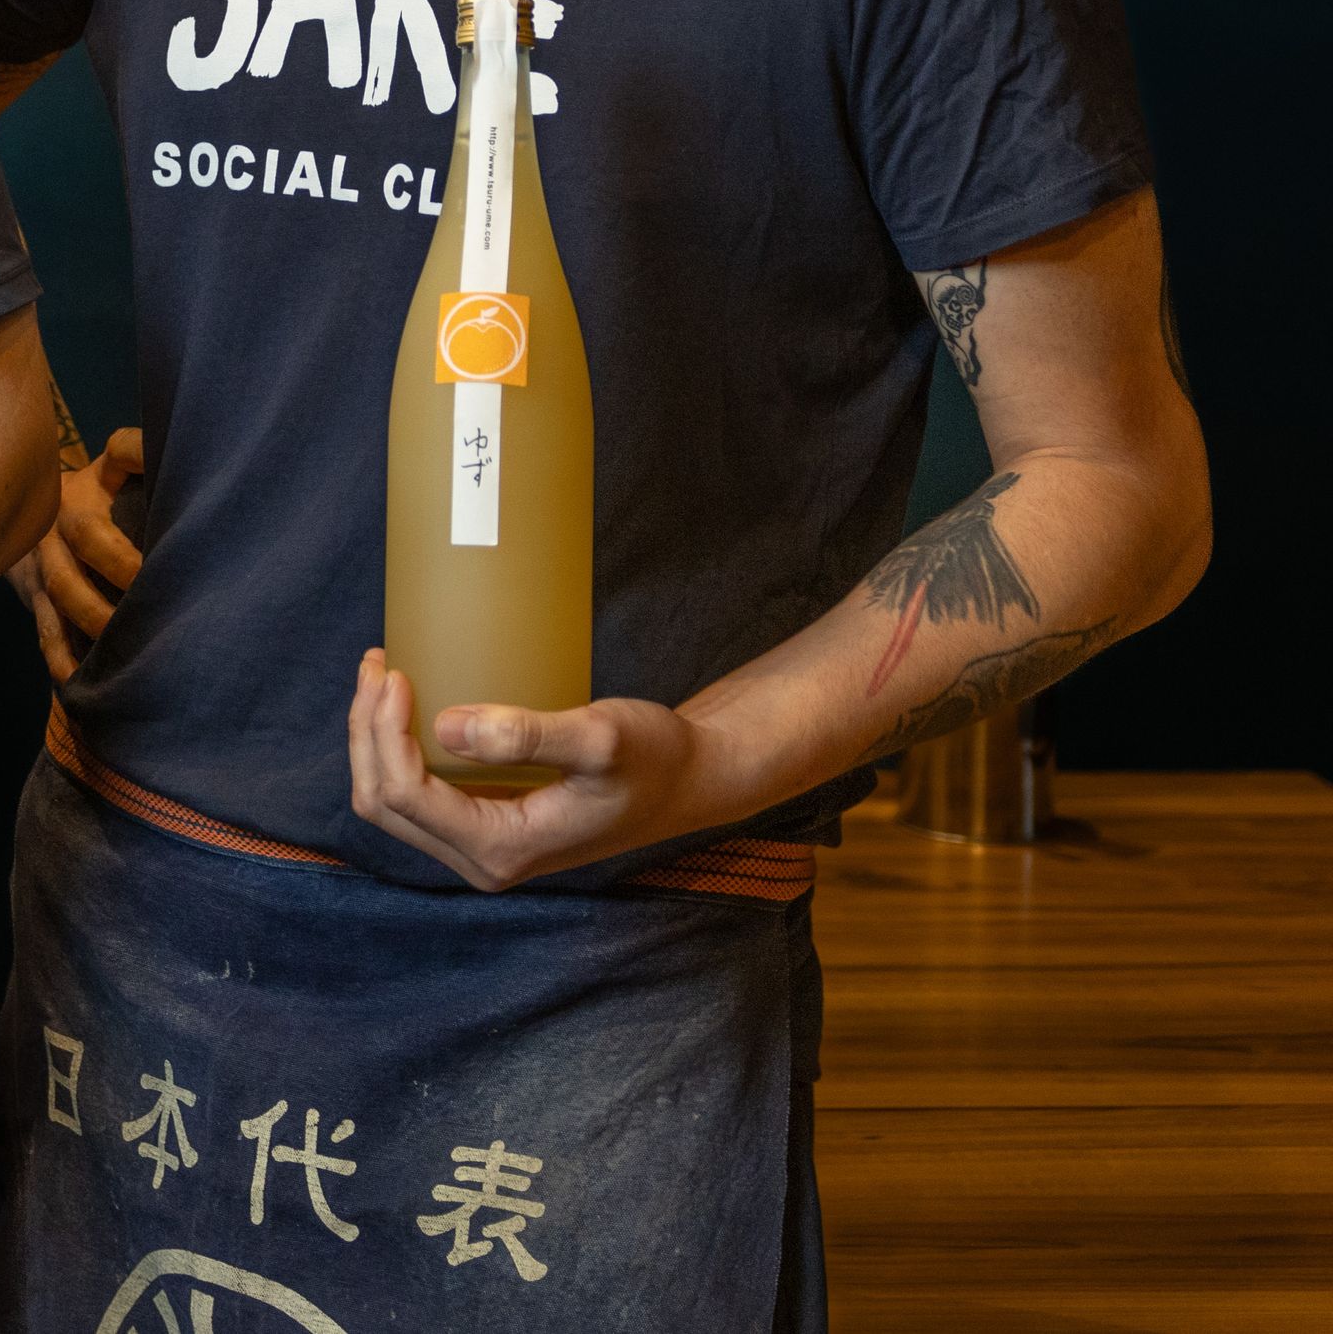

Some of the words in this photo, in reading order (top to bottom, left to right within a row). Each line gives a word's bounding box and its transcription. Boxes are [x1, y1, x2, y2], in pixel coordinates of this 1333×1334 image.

[152, 141, 359, 203] SOCIAL
[382, 162, 443, 217] CL
[461, 427, 492, 487] ゆず
[43, 1026, 548, 1282] 日本代表
